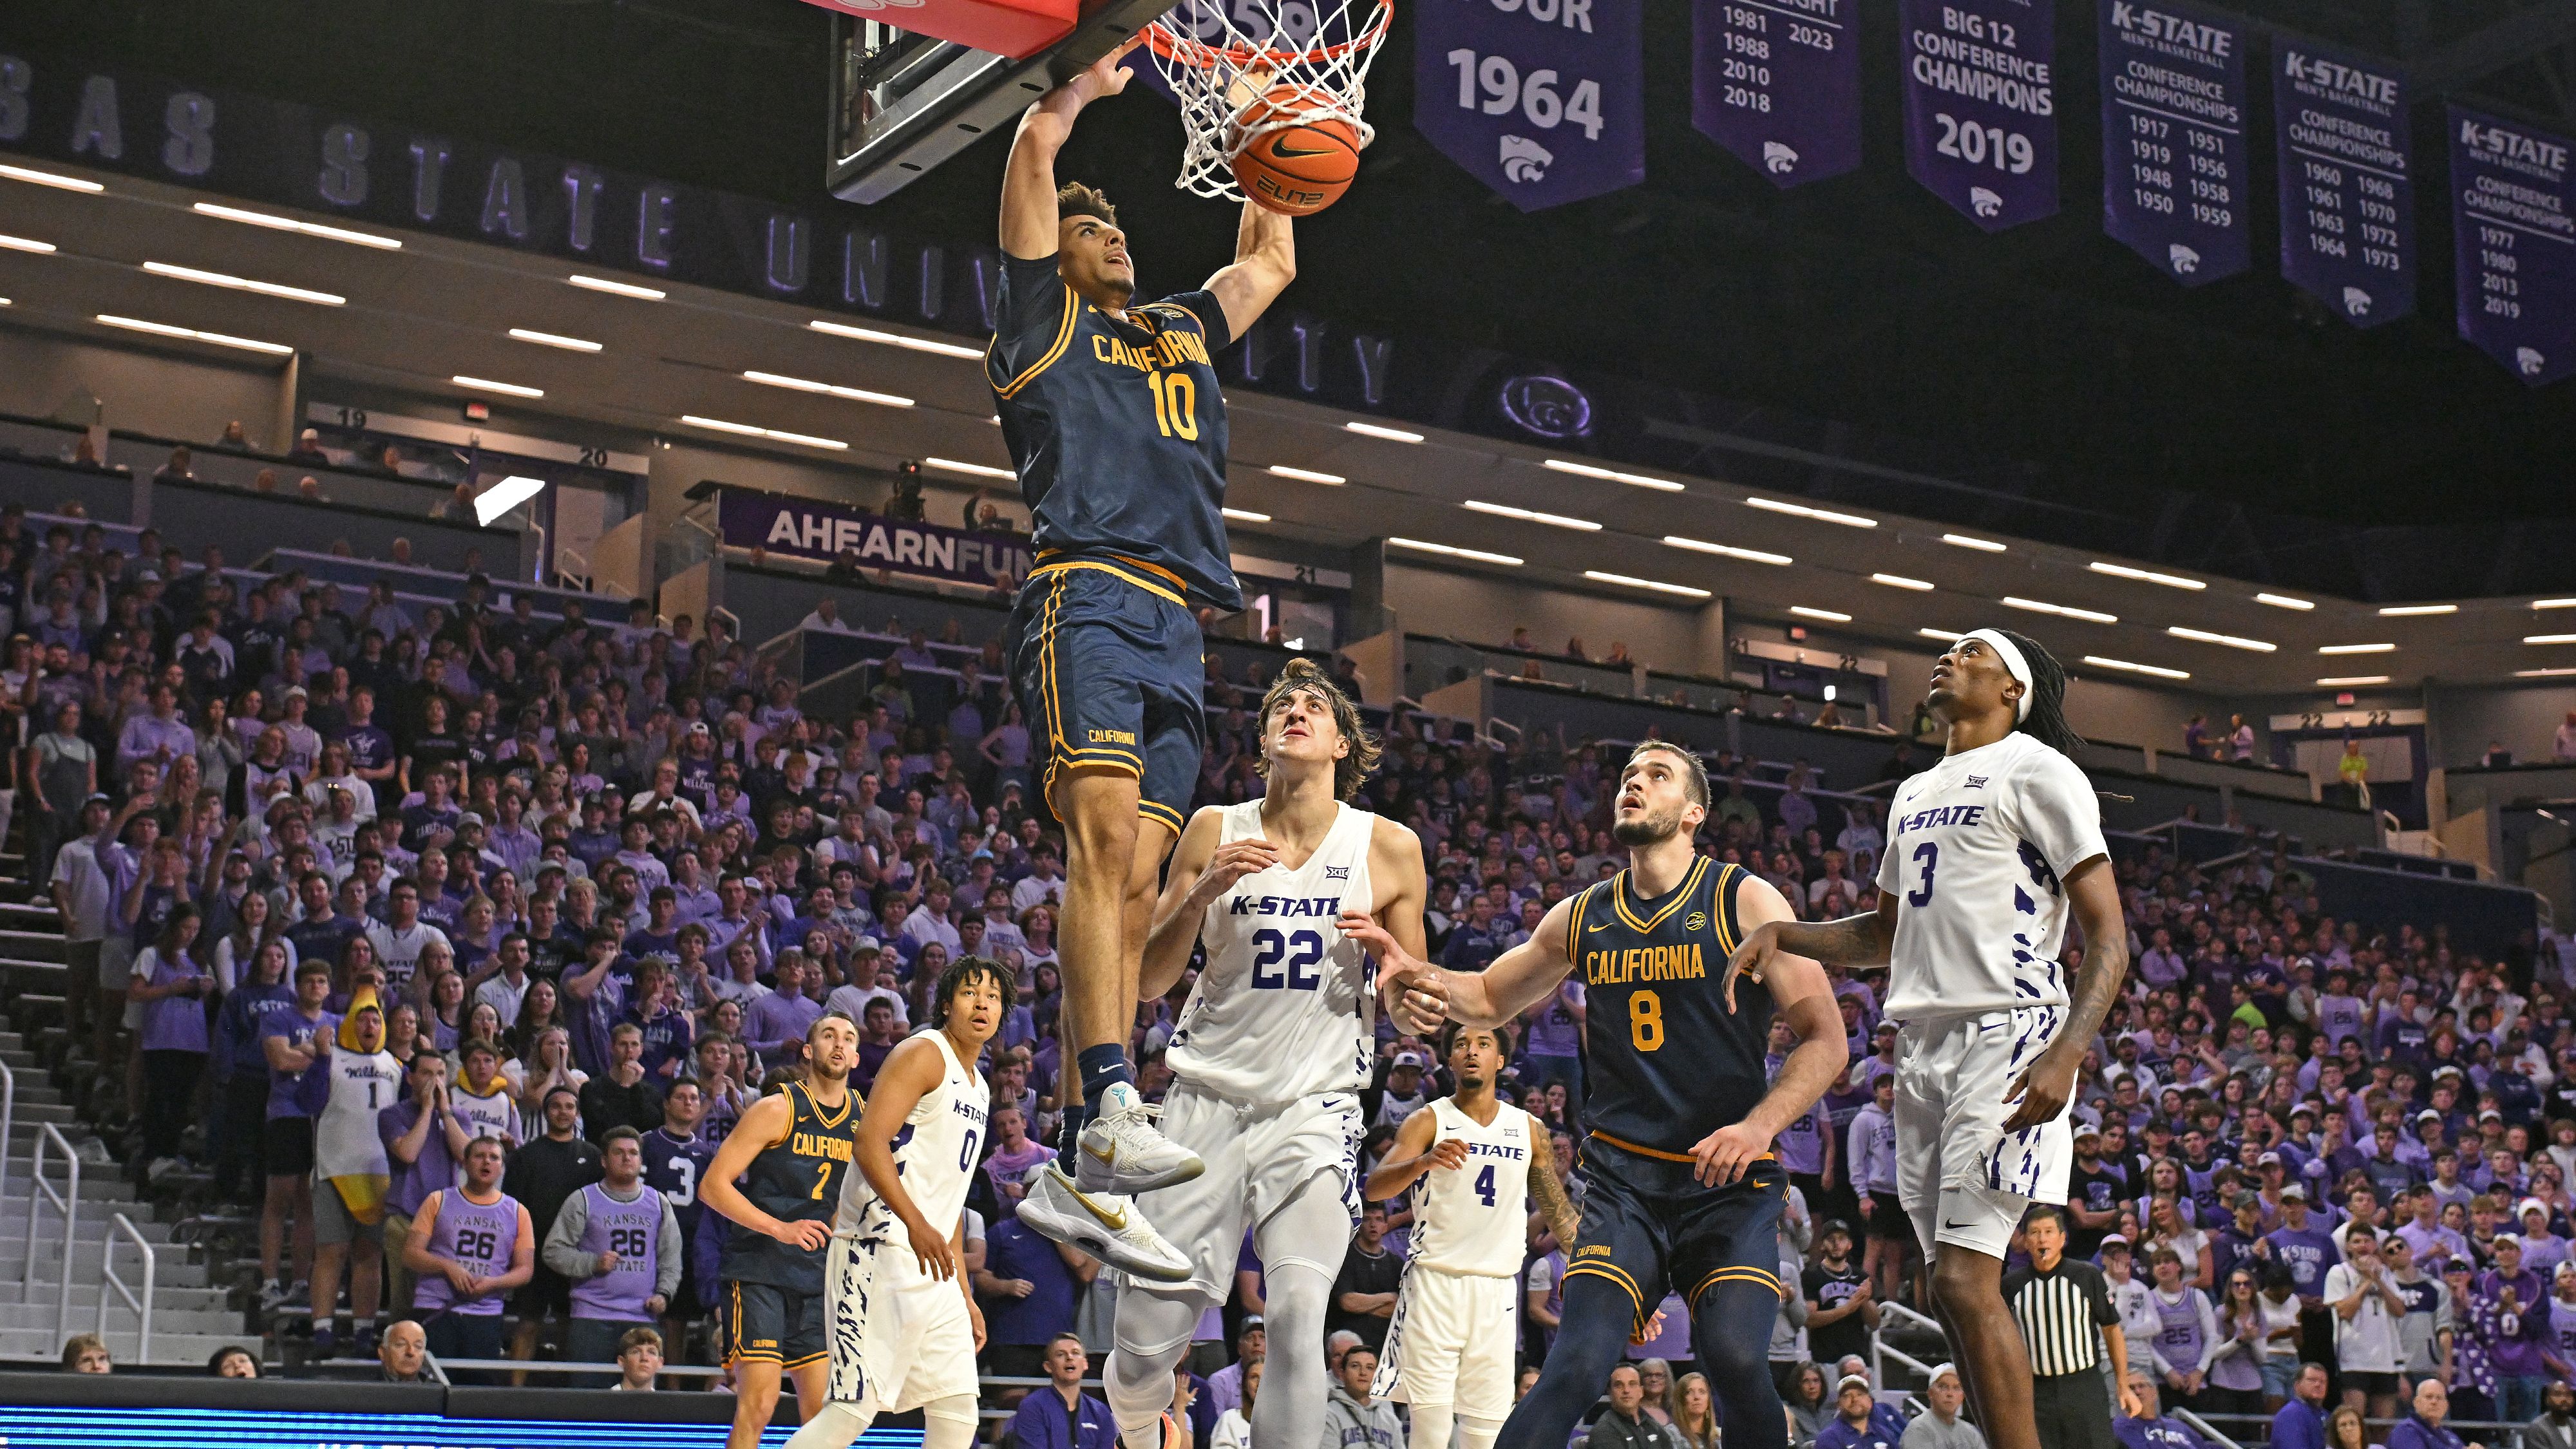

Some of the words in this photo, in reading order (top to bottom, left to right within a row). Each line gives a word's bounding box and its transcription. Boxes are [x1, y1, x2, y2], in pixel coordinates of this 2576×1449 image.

[1723, 6, 1766, 32] 1981
[1943, 6, 1984, 39] BIG
[1989, 22, 2016, 49] 12
[2111, 1, 2231, 57] K-STATE
[1724, 32, 1769, 59] 1988
[1789, 23, 1833, 50] 2023
[1913, 30, 2050, 84] CONFERENCE
[1723, 58, 1770, 86] 2010
[1913, 55, 2053, 116] CHAMPIONS
[2127, 60, 2224, 101] CONFERENCE
[2285, 51, 2398, 106] K-STATE
[1448, 48, 1603, 141] 1964
[1724, 85, 1770, 113] 2018
[2114, 75, 2239, 123] CHAMPIONSHIPS
[2130, 115, 2169, 139] 1917
[2301, 109, 2391, 147] CONFERENCE
[1935, 113, 2034, 175] 2019
[2131, 139, 2171, 164] 1919
[2187, 129, 2225, 155] 1951
[2289, 124, 2405, 169] CHAMPIONSHIPS
[2460, 119, 2568, 173] K-STATE
[2132, 164, 2173, 189] 1948
[2189, 153, 2228, 179] 1956
[2304, 161, 2342, 187] 1960
[319, 124, 671, 268] STATE
[1256, 174, 1325, 205] ELITE
[2134, 188, 2174, 214] 1950
[2190, 178, 2230, 204] 1958
[2306, 185, 2342, 210] 1961
[2475, 175, 2562, 213] CONFERENCE
[2192, 202, 2231, 228] 1959
[2309, 209, 2344, 234] 1963
[2359, 198, 2396, 223] 1970
[2463, 191, 2575, 233] CHAMPIONSHIPS
[2310, 233, 2347, 258] 1964
[2361, 223, 2398, 247] 1972
[2363, 246, 2400, 270] 1973
[2481, 249, 2517, 272] 1980
[2482, 272, 2518, 296] 2013
[2484, 295, 2521, 319] 2019
[1092, 330, 1212, 372] CALIFORNIA
[336, 410, 366, 428] 19
[1147, 370, 1198, 441] 10
[580, 450, 608, 468] 20
[1296, 566, 1316, 583] 21
[1839, 654, 1858, 673] 22
[2300, 713, 2322, 726] 22
[2367, 710, 2390, 724] 22
[1088, 729, 1135, 746] CALIFORNIA
[1897, 805, 1985, 837] K-STATE
[1908, 842, 1939, 908] 3
[1229, 895, 1341, 918] K-STATE
[1251, 928, 1323, 991] 22
[1586, 943, 1705, 986] CALIFORNIA
[1628, 989, 1665, 1052] 8
[370, 1081, 378, 1109] 1
[959, 1128, 977, 1173] 0
[1468, 1142, 1524, 1160] STATE
[667, 1156, 696, 1206] 3
[811, 1162, 832, 1200] 2
[1474, 1164, 1496, 1208] 4
[452, 1214, 504, 1233] KANSAS
[603, 1213, 652, 1228] KANSAS
[455, 1229, 495, 1260] 26
[610, 1229, 646, 1256] 26
[1577, 1245, 1611, 1258] CALIFORNIA
[2163, 1327, 2192, 1345] 25
